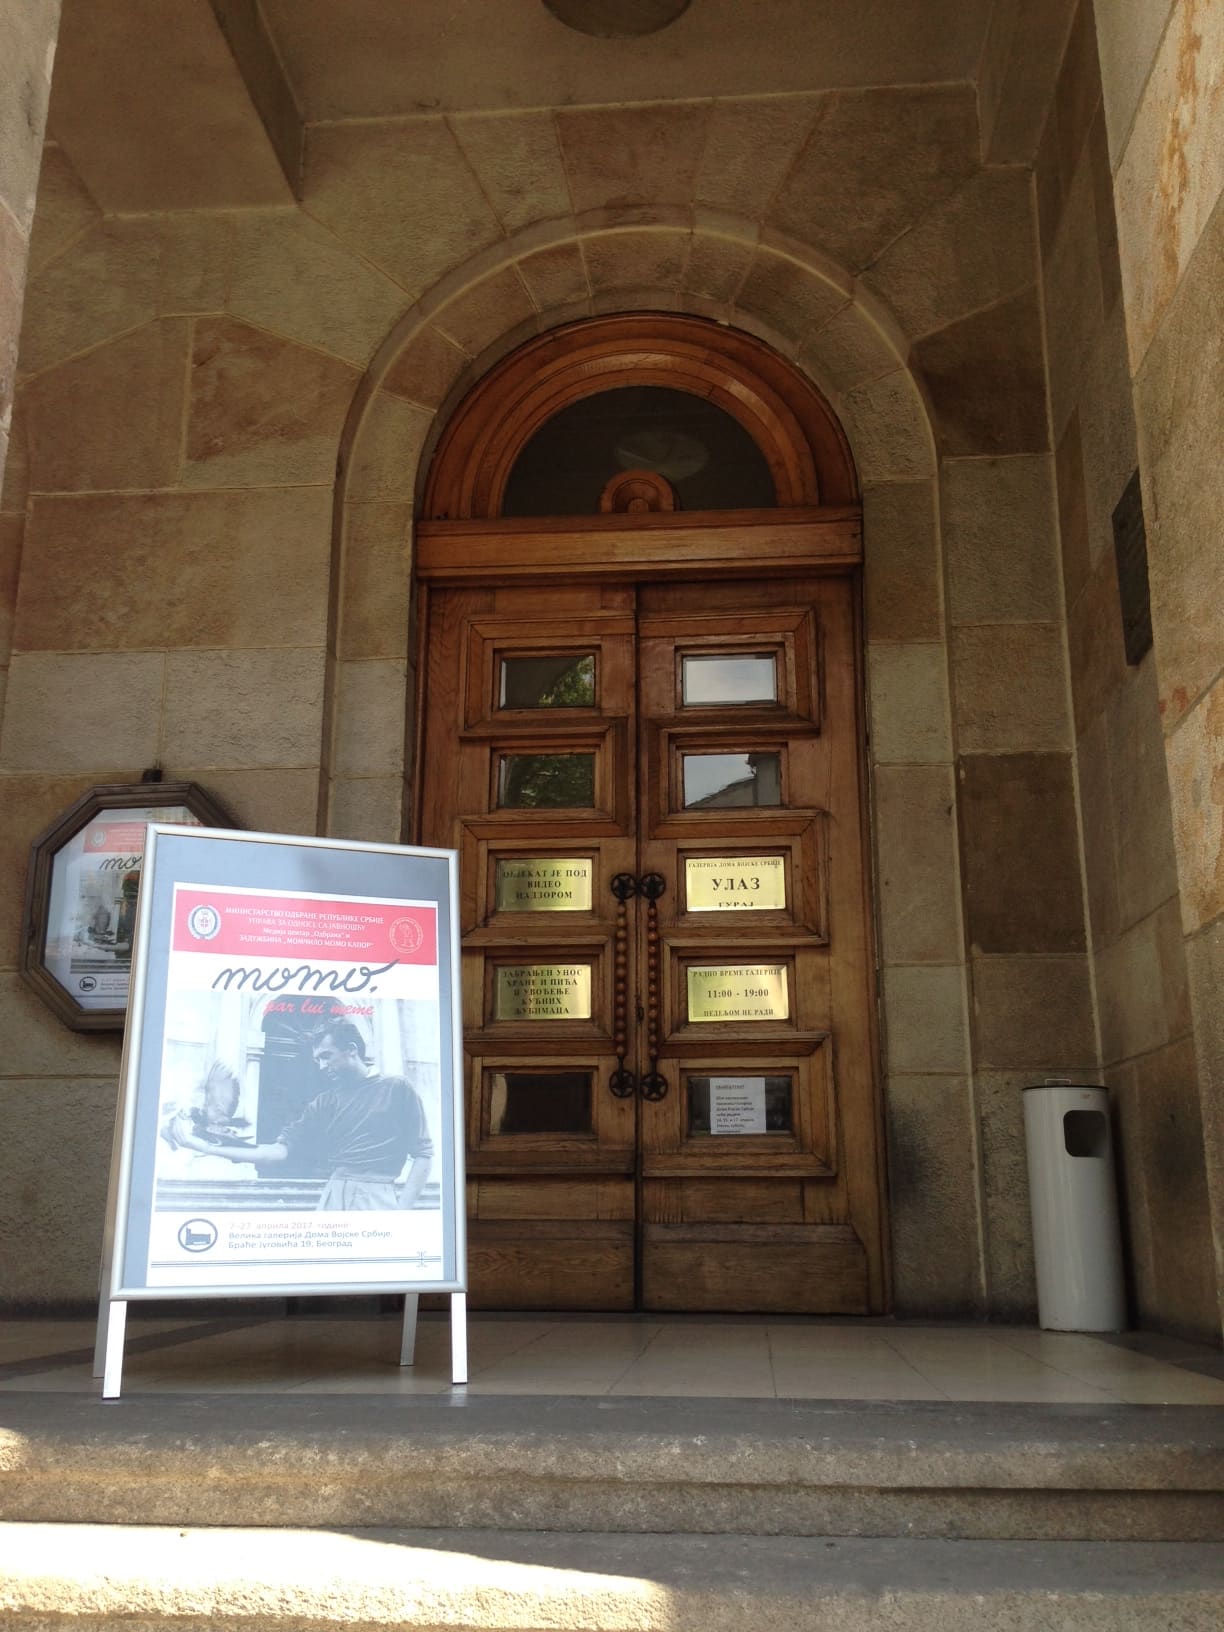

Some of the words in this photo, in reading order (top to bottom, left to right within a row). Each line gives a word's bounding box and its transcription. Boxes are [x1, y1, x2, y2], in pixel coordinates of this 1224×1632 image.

[100, 856, 142, 870] mo
[551, 870, 562, 878] ЈЕ
[566, 869, 587, 877] ПОД
[712, 878, 760, 890] УЛАЗ
[516, 891, 572, 899] НАДЗОРОМ
[285, 910, 318, 920] ОДБРАНЕ
[319, 913, 358, 922] РЕПУБЛИКЕ
[360, 916, 385, 924] СРБИЈЕ
[279, 918, 287, 926] ЗА
[504, 969, 553, 977] ЗАБРАЊЕН
[556, 968, 582, 976] УНОС
[506, 979, 536, 987] ХРАНЕ
[514, 989, 520, 997] И
[708, 990, 732, 998] 11:00
[744, 989, 769, 998] 19:00
[263, 998, 296, 1016] par
[301, 997, 324, 1013] lui
[754, 1008, 774, 1016] РАДИ
[256, 1223, 288, 1231] априла
[264, 1231, 303, 1240] галерија
[304, 1231, 329, 1239] Дома
[331, 1230, 359, 1239] Војске
[228, 1240, 257, 1250] Браће
[259, 1240, 298, 1250] Југовића
[316, 1239, 353, 1248] Београд
